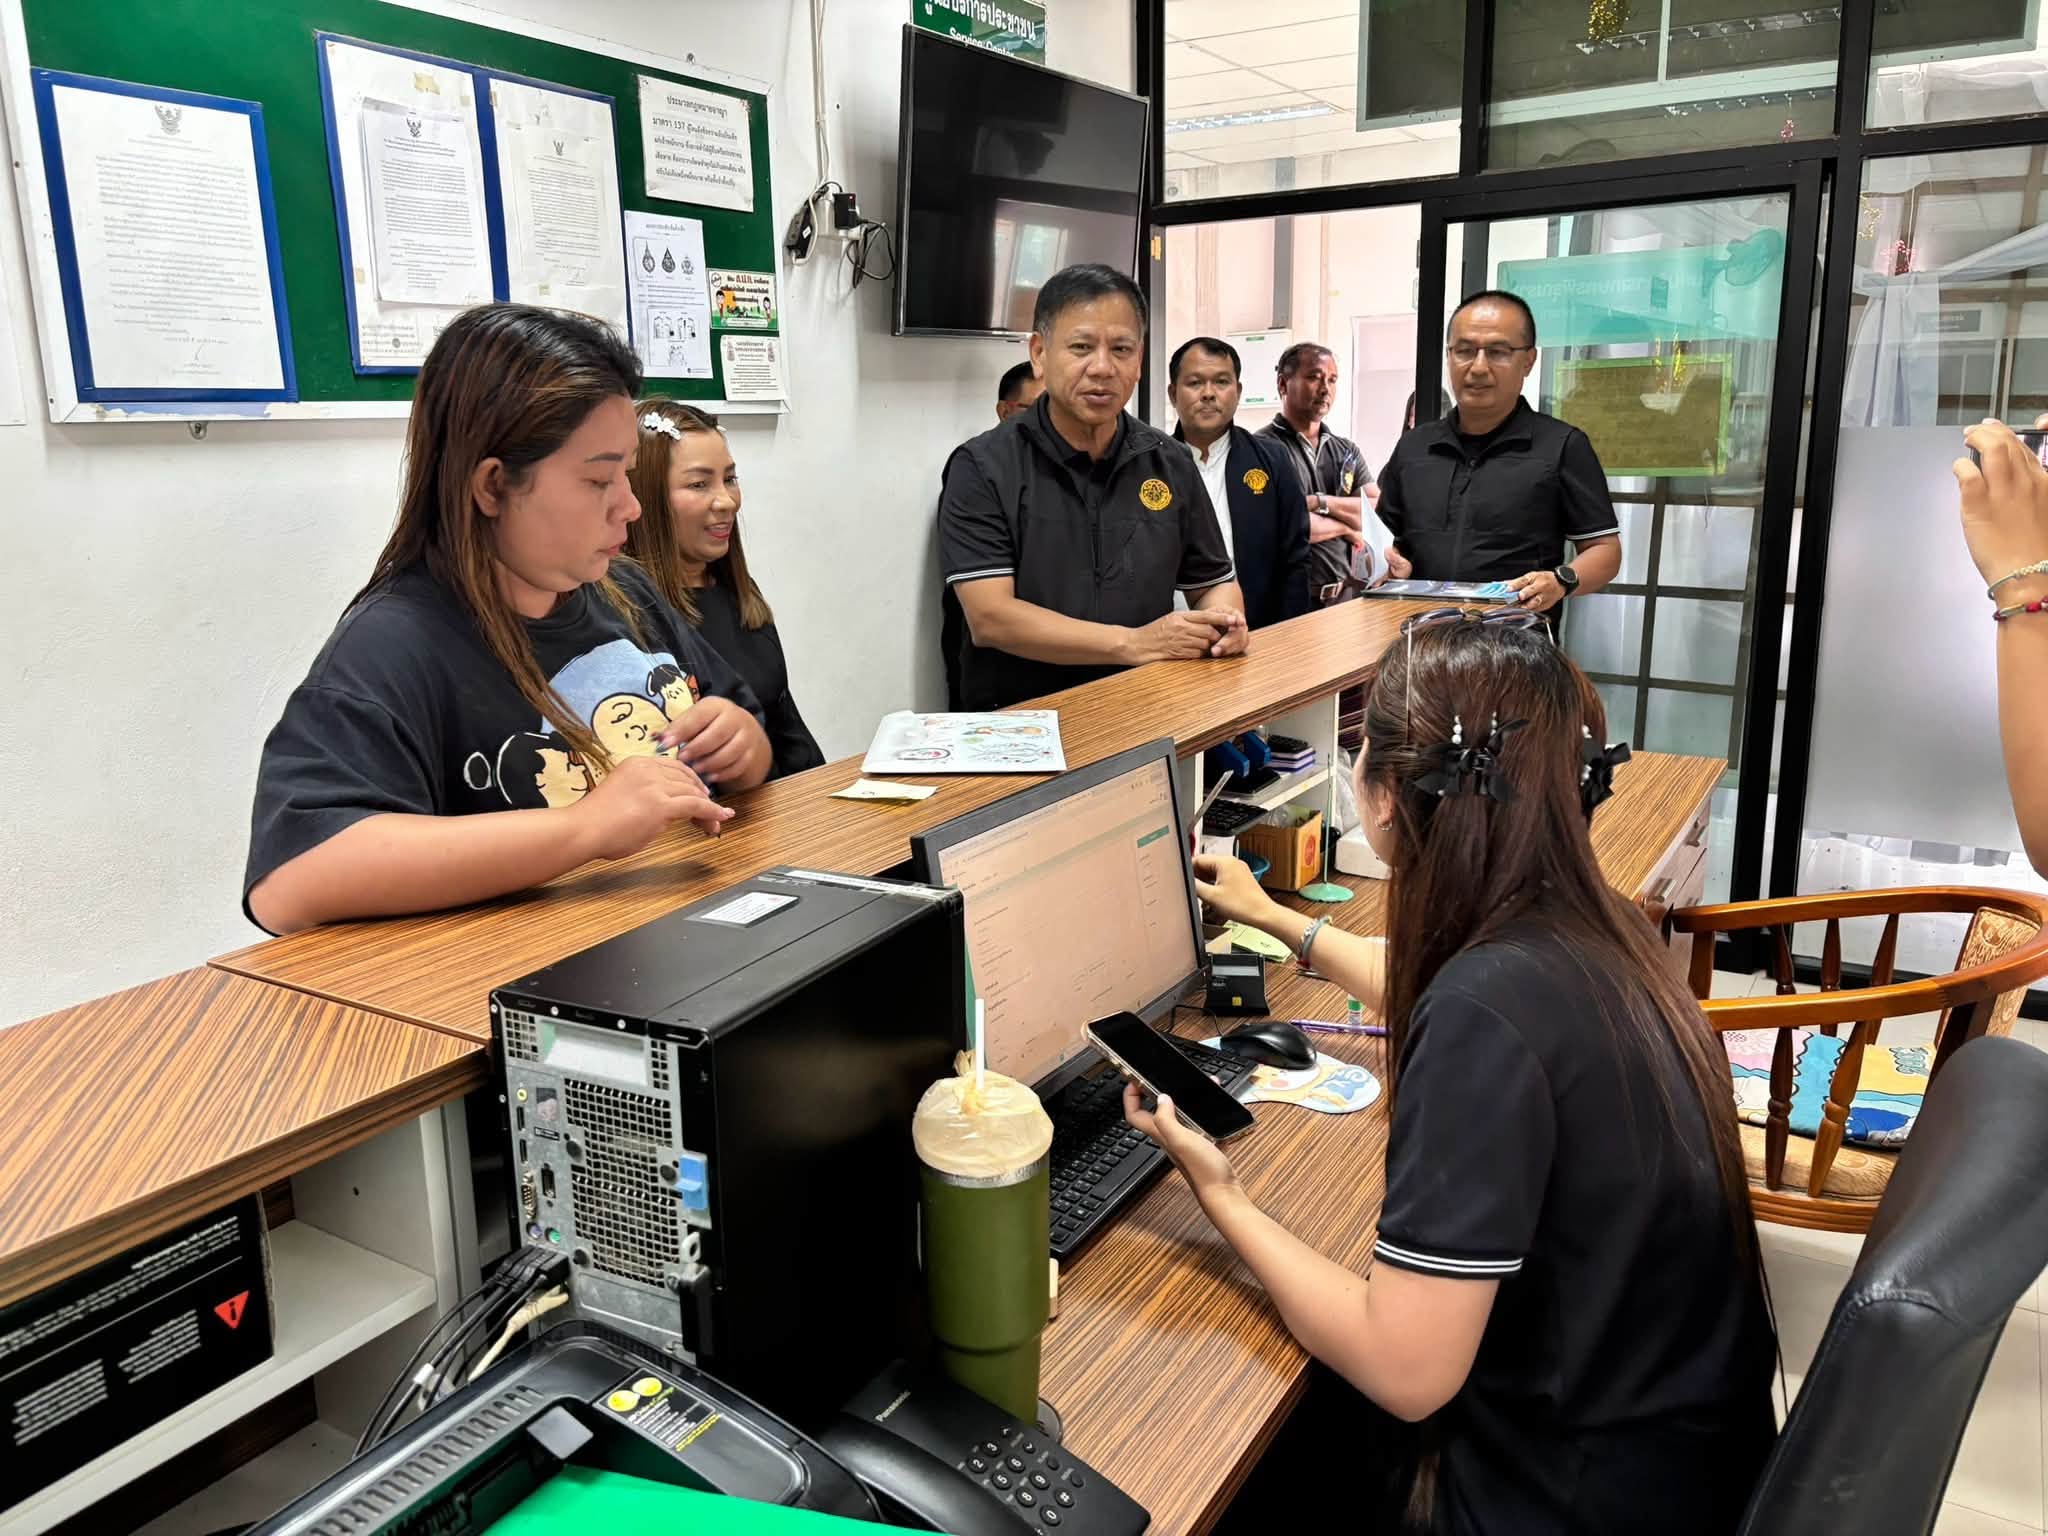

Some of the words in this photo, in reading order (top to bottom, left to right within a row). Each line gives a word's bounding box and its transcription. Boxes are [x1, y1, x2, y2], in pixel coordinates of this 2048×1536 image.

[987, 1442, 997, 1451] 3
[973, 1459, 984, 1468] 2
[1011, 1458, 1021, 1467] 6
[997, 1475, 1008, 1484] 5
[1035, 1475, 1046, 1484] 9
[1022, 1492, 1032, 1501] 8
[1046, 1510, 1057, 1519] 0
